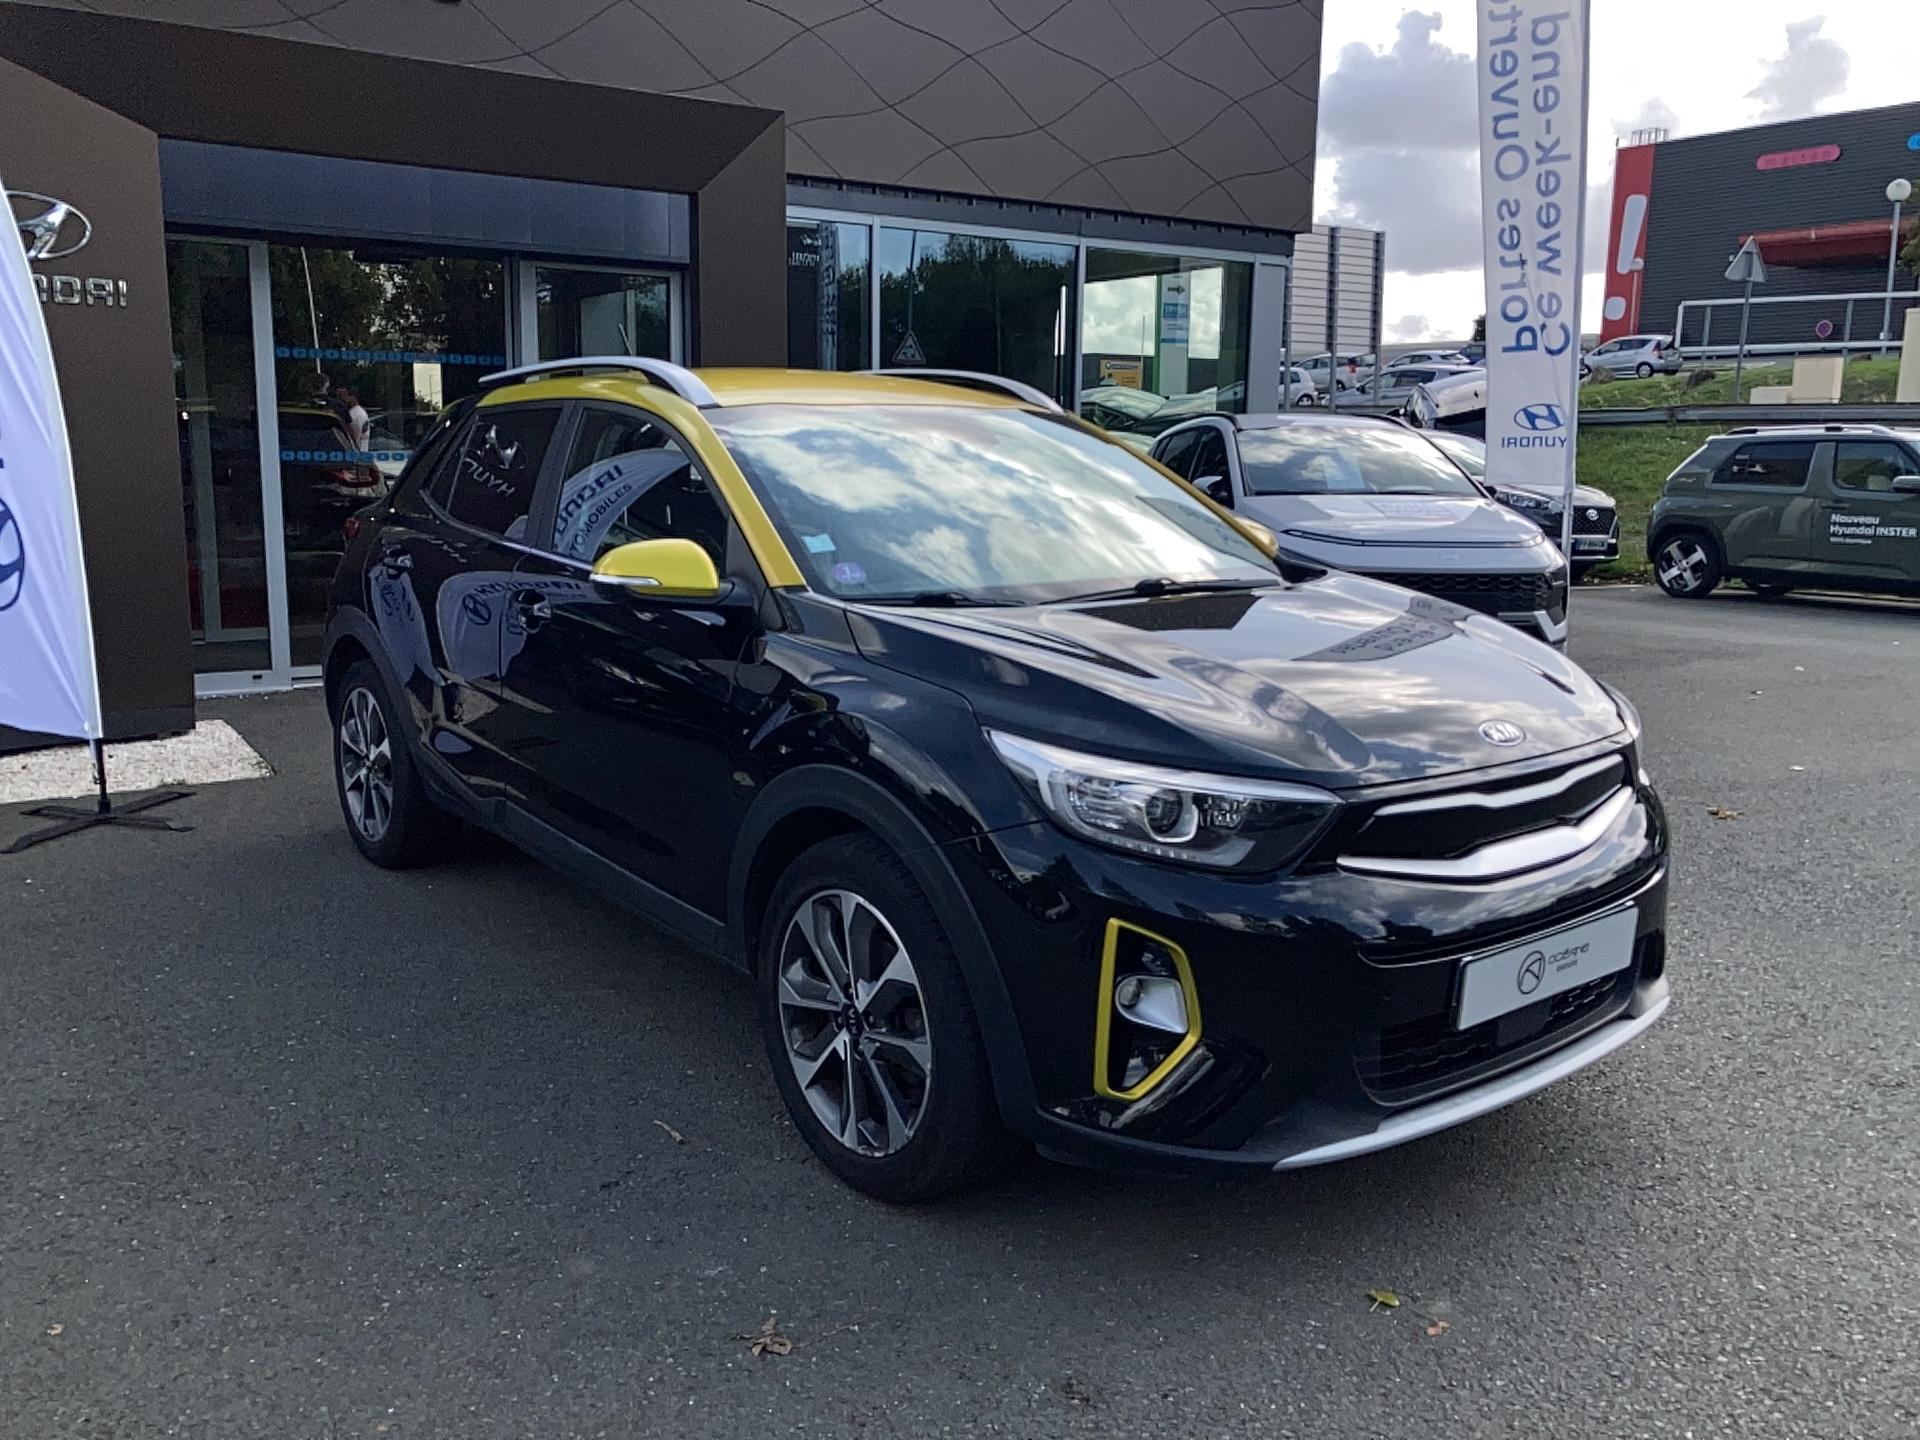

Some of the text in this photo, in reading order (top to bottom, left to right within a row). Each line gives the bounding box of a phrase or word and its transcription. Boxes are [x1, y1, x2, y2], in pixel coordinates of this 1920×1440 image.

[1831, 513, 1880, 525] Nouveau
[1830, 524, 1918, 538] Hyundai INSTER
